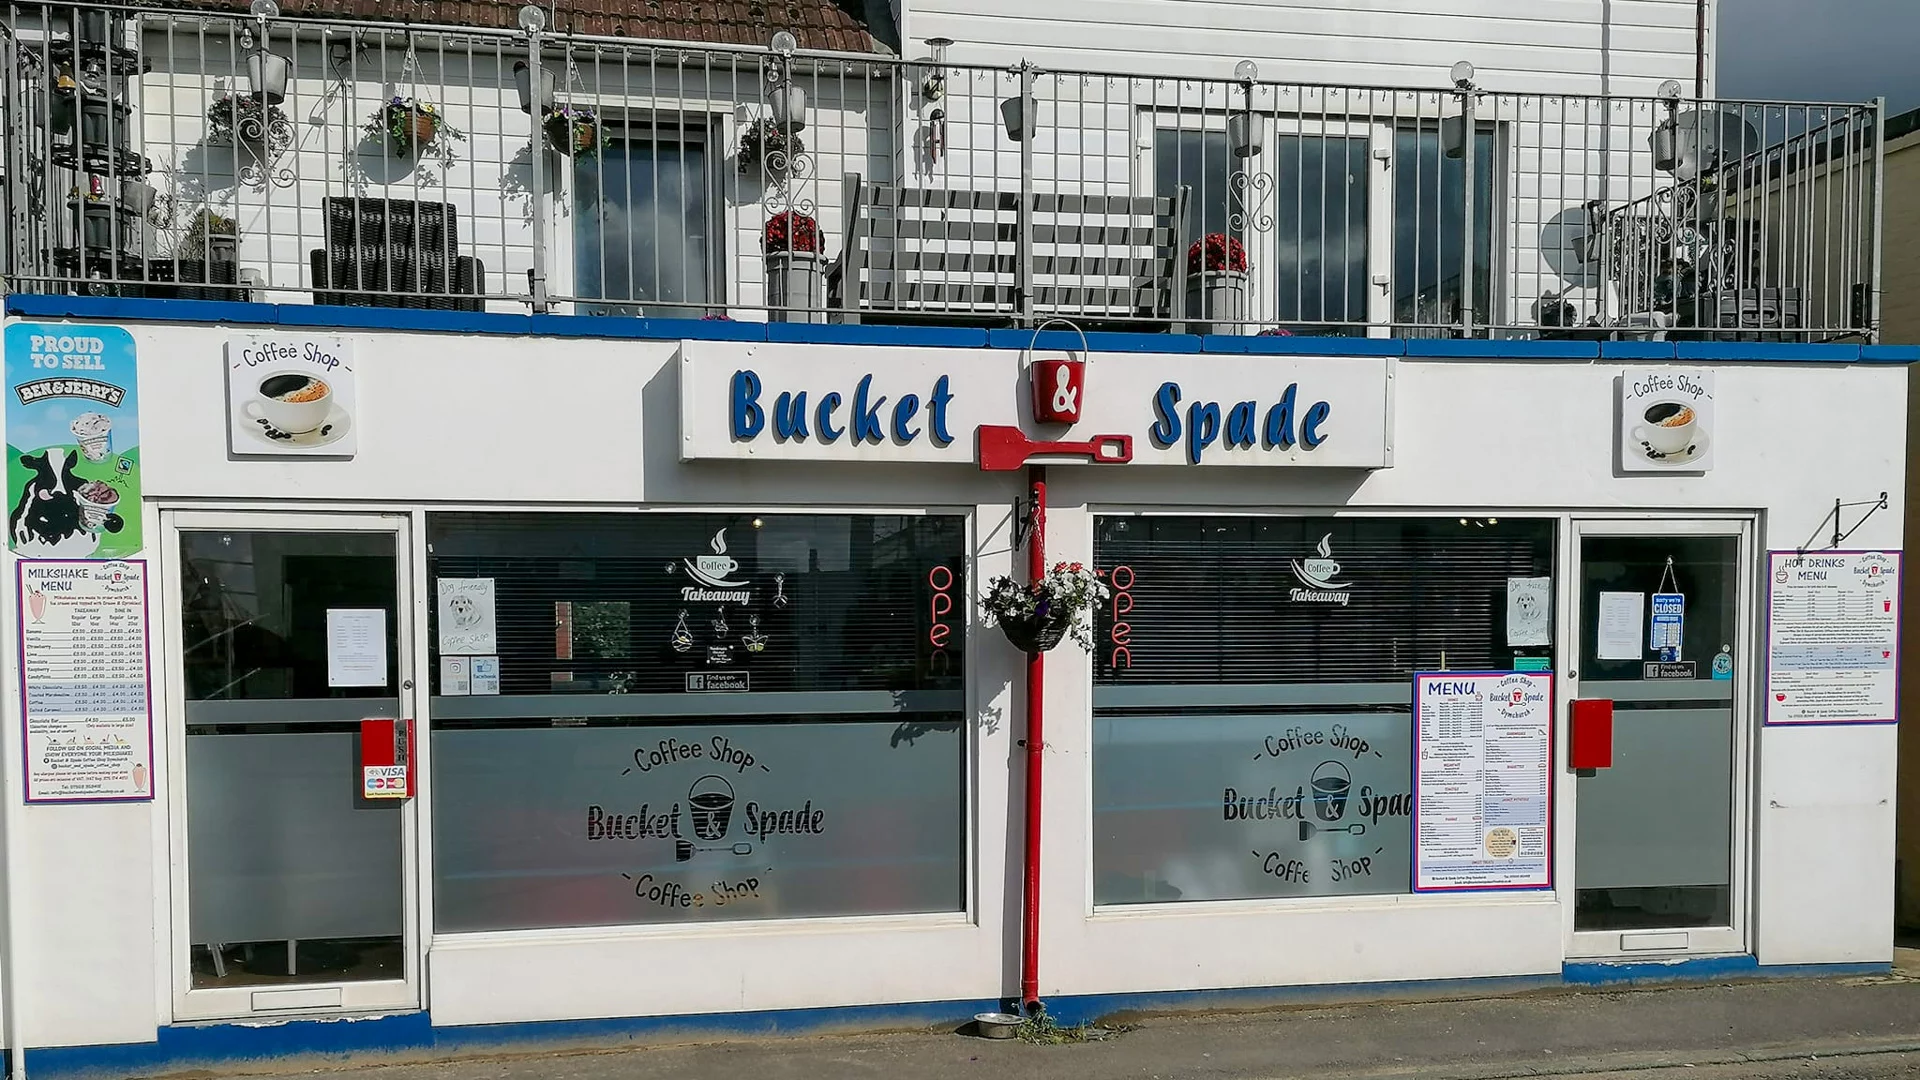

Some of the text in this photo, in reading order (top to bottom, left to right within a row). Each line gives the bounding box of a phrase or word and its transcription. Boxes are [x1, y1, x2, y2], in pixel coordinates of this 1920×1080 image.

[30, 335, 104, 353] PROUD
[31, 354, 105, 370] TO SELL
[244, 342, 339, 372] Coffee Shop
[1634, 375, 1704, 400] Coffee Shop
[733, 364, 1331, 464] Bucket & Spade
[702, 561, 726, 570] Coffee
[1308, 564, 1330, 573] Coffee
[1785, 559, 1845, 567] HOT DRINKS
[28, 569, 88, 578] MILKSHAKE
[1798, 572, 1827, 580] MENU
[41, 582, 72, 591] MENU
[440, 583, 454, 595] Dog
[681, 587, 750, 605] Takeaway
[1290, 588, 1349, 606] Takeaway
[1655, 604, 1682, 614] CLOSED
[707, 680, 745, 689] facebook
[1429, 682, 1475, 695] MENU
[1524, 693, 1543, 701] Spade
[1265, 724, 1369, 759] Coffee Shop
[634, 736, 755, 773] Coffee Shop
[1224, 786, 1305, 820] Bucket
[1326, 795, 1339, 818] &
[588, 800, 824, 844] Bucket & Spade
[1331, 857, 1371, 882] Shop
[635, 875, 759, 907] Coffee Shop
